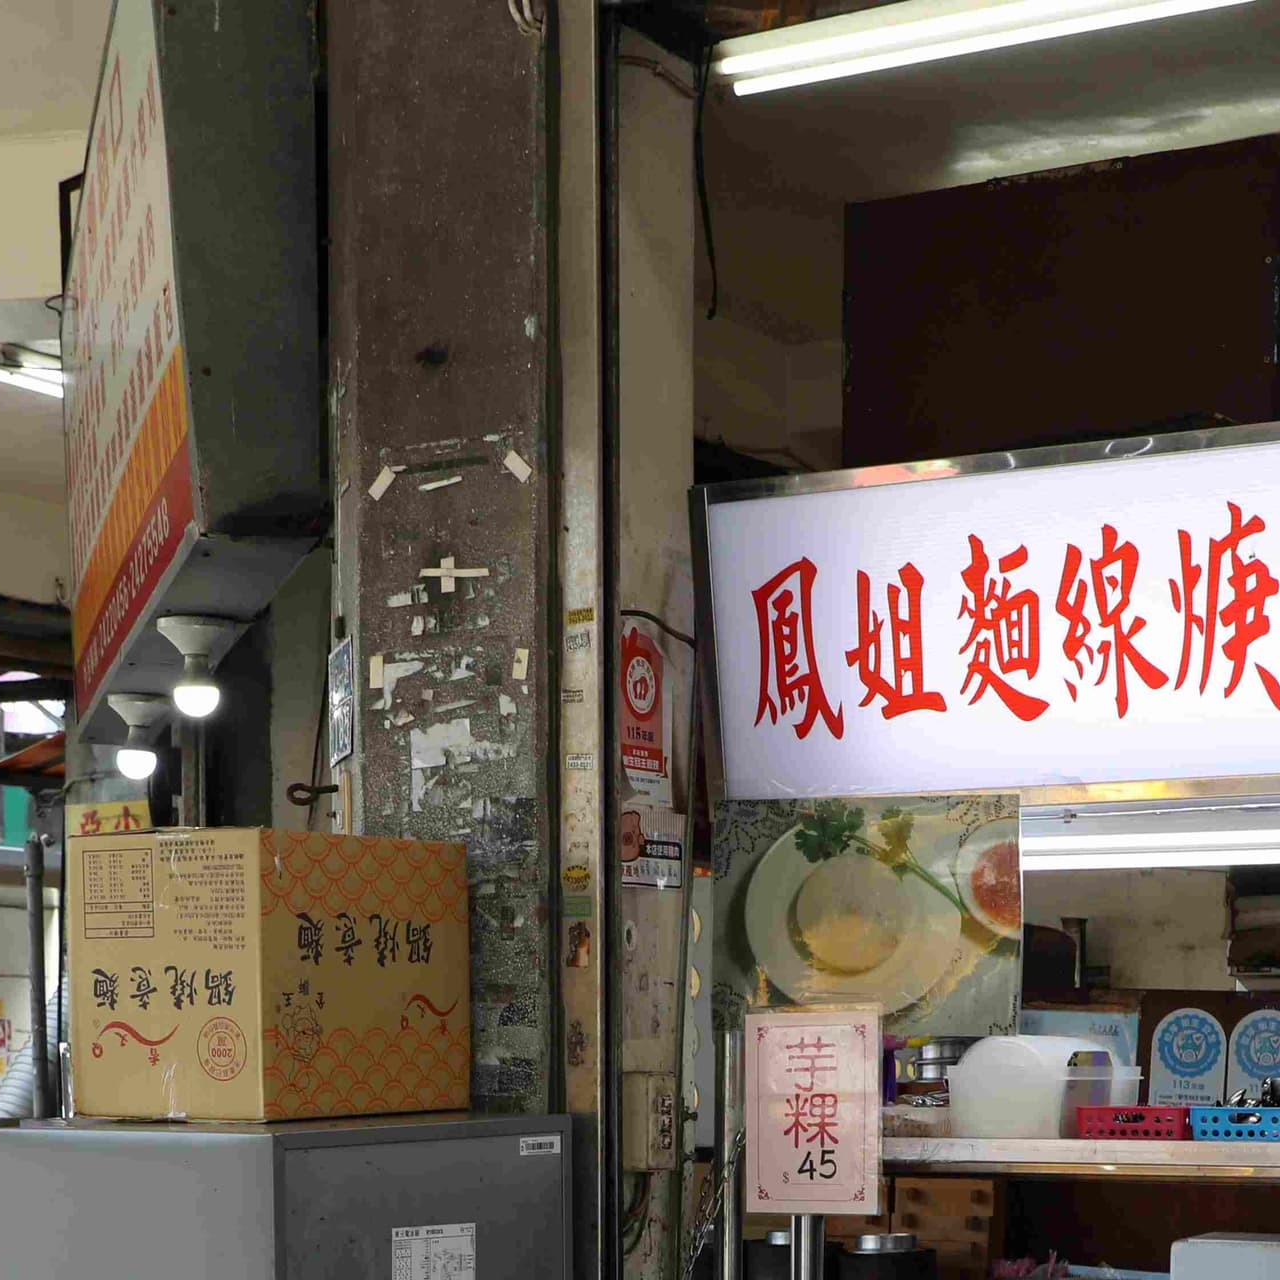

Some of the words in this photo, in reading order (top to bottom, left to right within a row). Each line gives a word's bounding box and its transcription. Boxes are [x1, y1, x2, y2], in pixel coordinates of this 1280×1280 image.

[297, 912, 434, 967] 鍋燒意麵
[91, 966, 236, 1011] 鍋燒意麵
[783, 1036, 839, 1148] 芋粿
